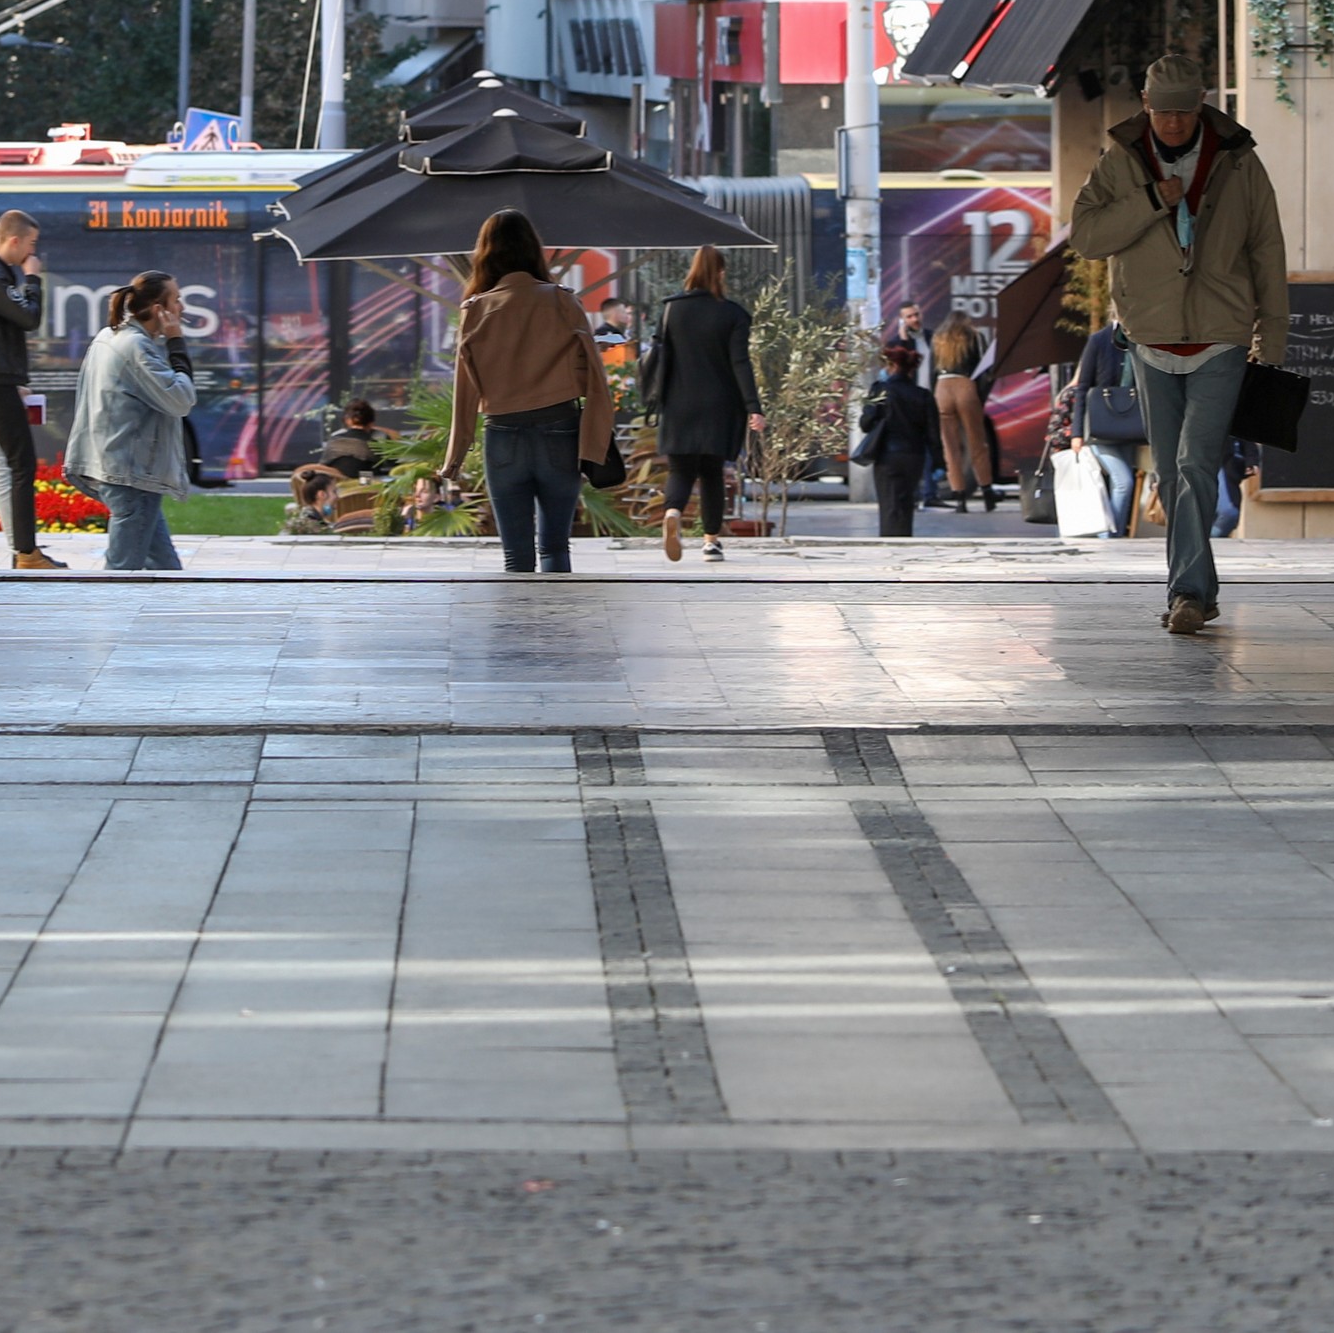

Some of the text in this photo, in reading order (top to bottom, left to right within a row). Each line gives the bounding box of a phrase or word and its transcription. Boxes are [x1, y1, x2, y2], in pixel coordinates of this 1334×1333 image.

[88, 200, 229, 229] 31 Konjarnik
[963, 209, 1033, 273] 12
